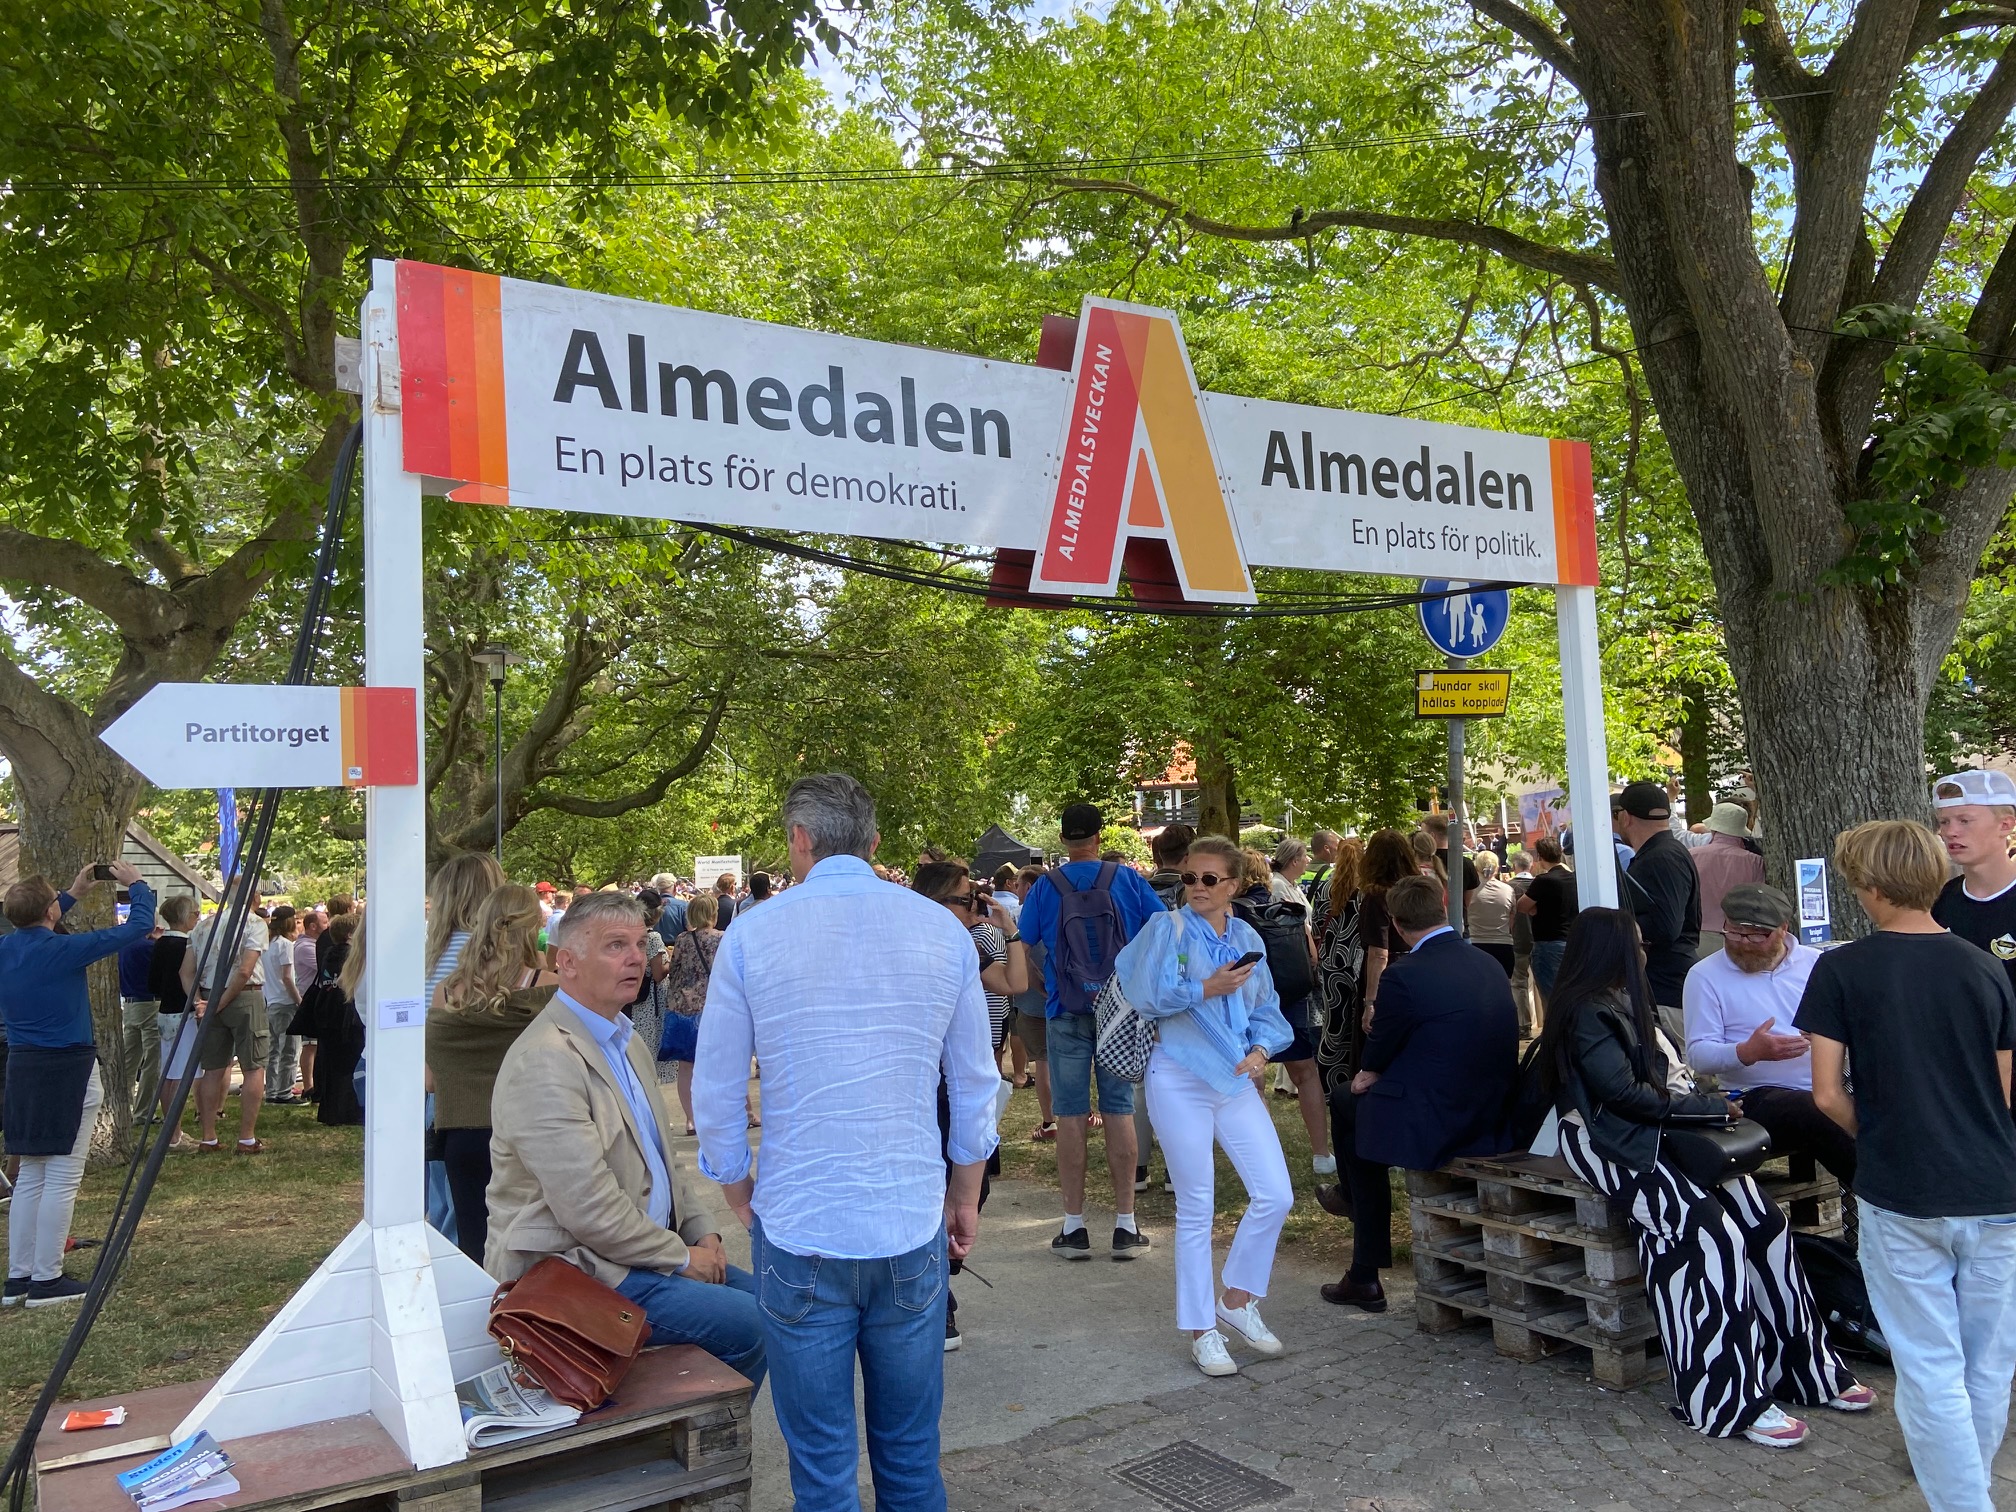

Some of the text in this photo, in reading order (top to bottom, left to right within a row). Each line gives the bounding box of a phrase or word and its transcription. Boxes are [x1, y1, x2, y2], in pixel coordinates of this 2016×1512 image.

[553, 328, 1013, 459] Almedalen
[1058, 341, 1112, 562] ALMEDALSVECKAN
[1261, 429, 1535, 512] Almedalen
[554, 436, 967, 513] En plats för demokrati.
[1352, 518, 1542, 561] En plats för politik.
[1422, 696, 1504, 709] hållas kopplade
[1433, 680, 1500, 693] Hundar skall
[185, 722, 330, 748] Partitorget
[128, 1448, 183, 1480] guiden
[141, 1449, 211, 1487] PROGRAM
